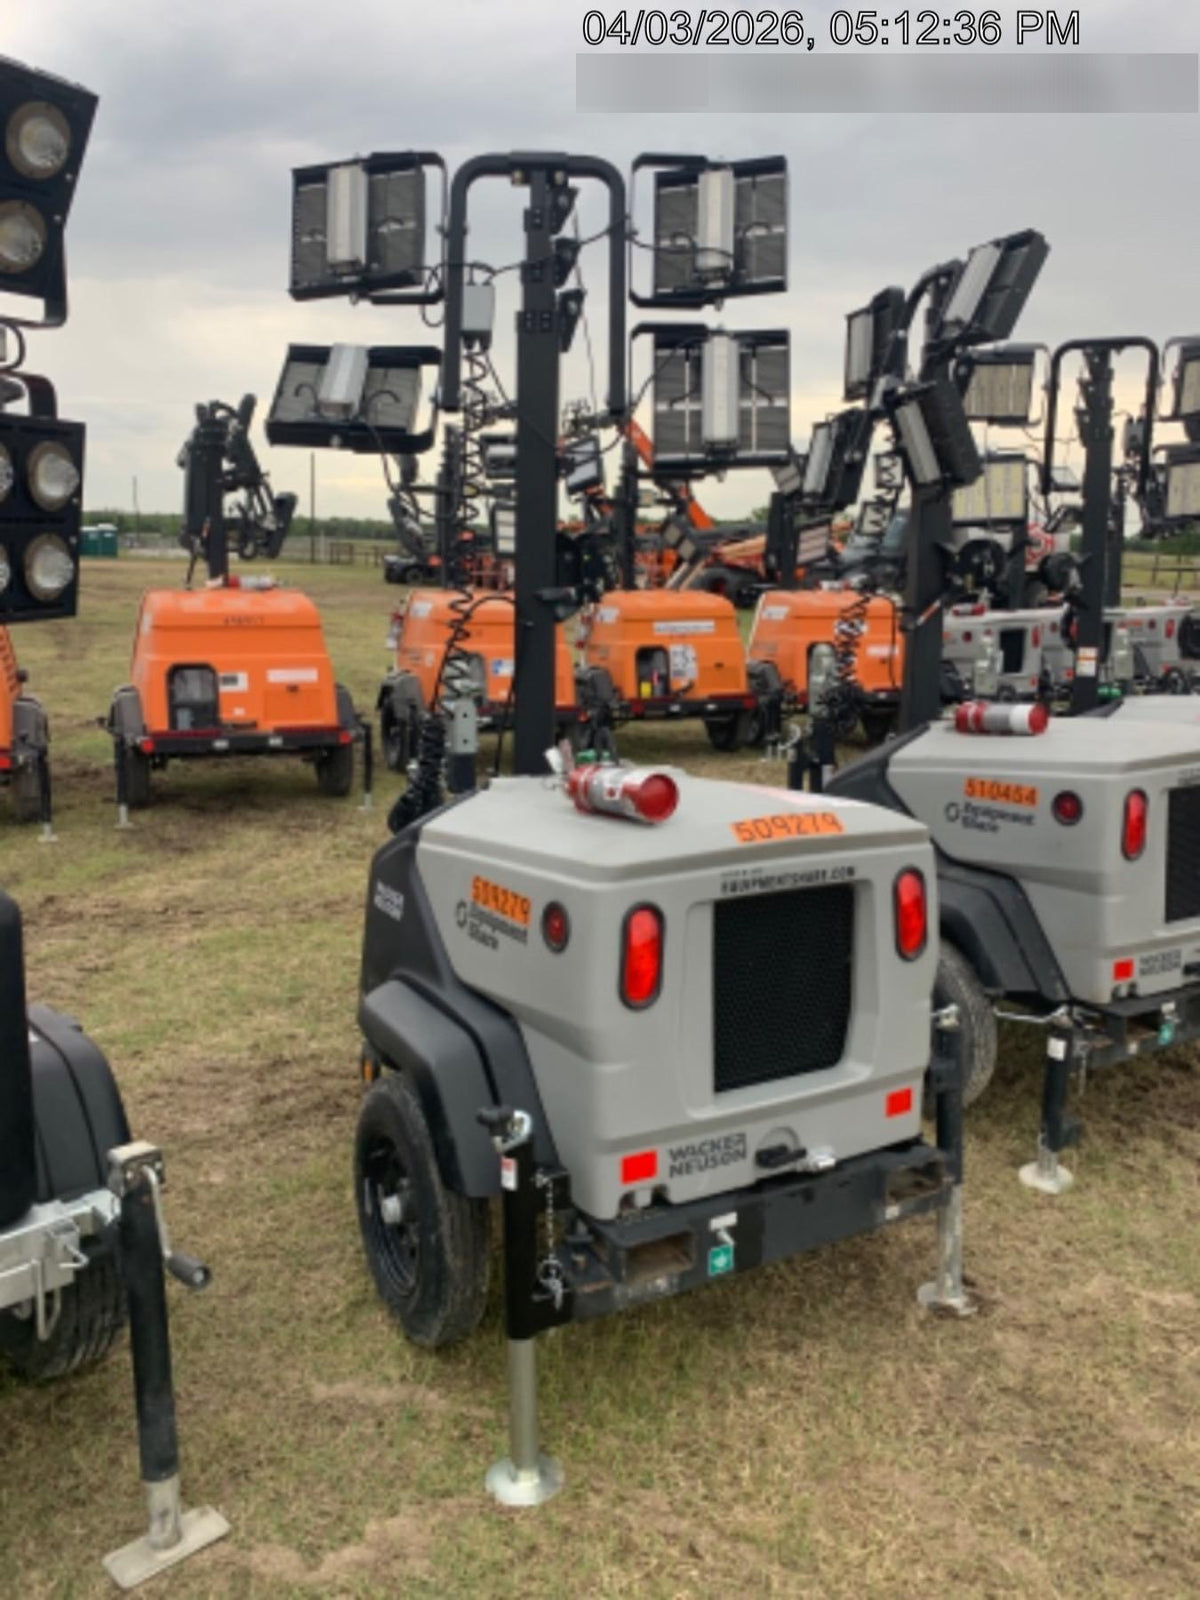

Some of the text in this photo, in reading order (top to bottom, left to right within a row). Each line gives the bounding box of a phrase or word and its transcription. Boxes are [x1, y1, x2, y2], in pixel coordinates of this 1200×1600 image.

[733, 812, 843, 842] 509279
[669, 1132, 747, 1161] WACKER
[669, 1149, 747, 1178] NEUSON
